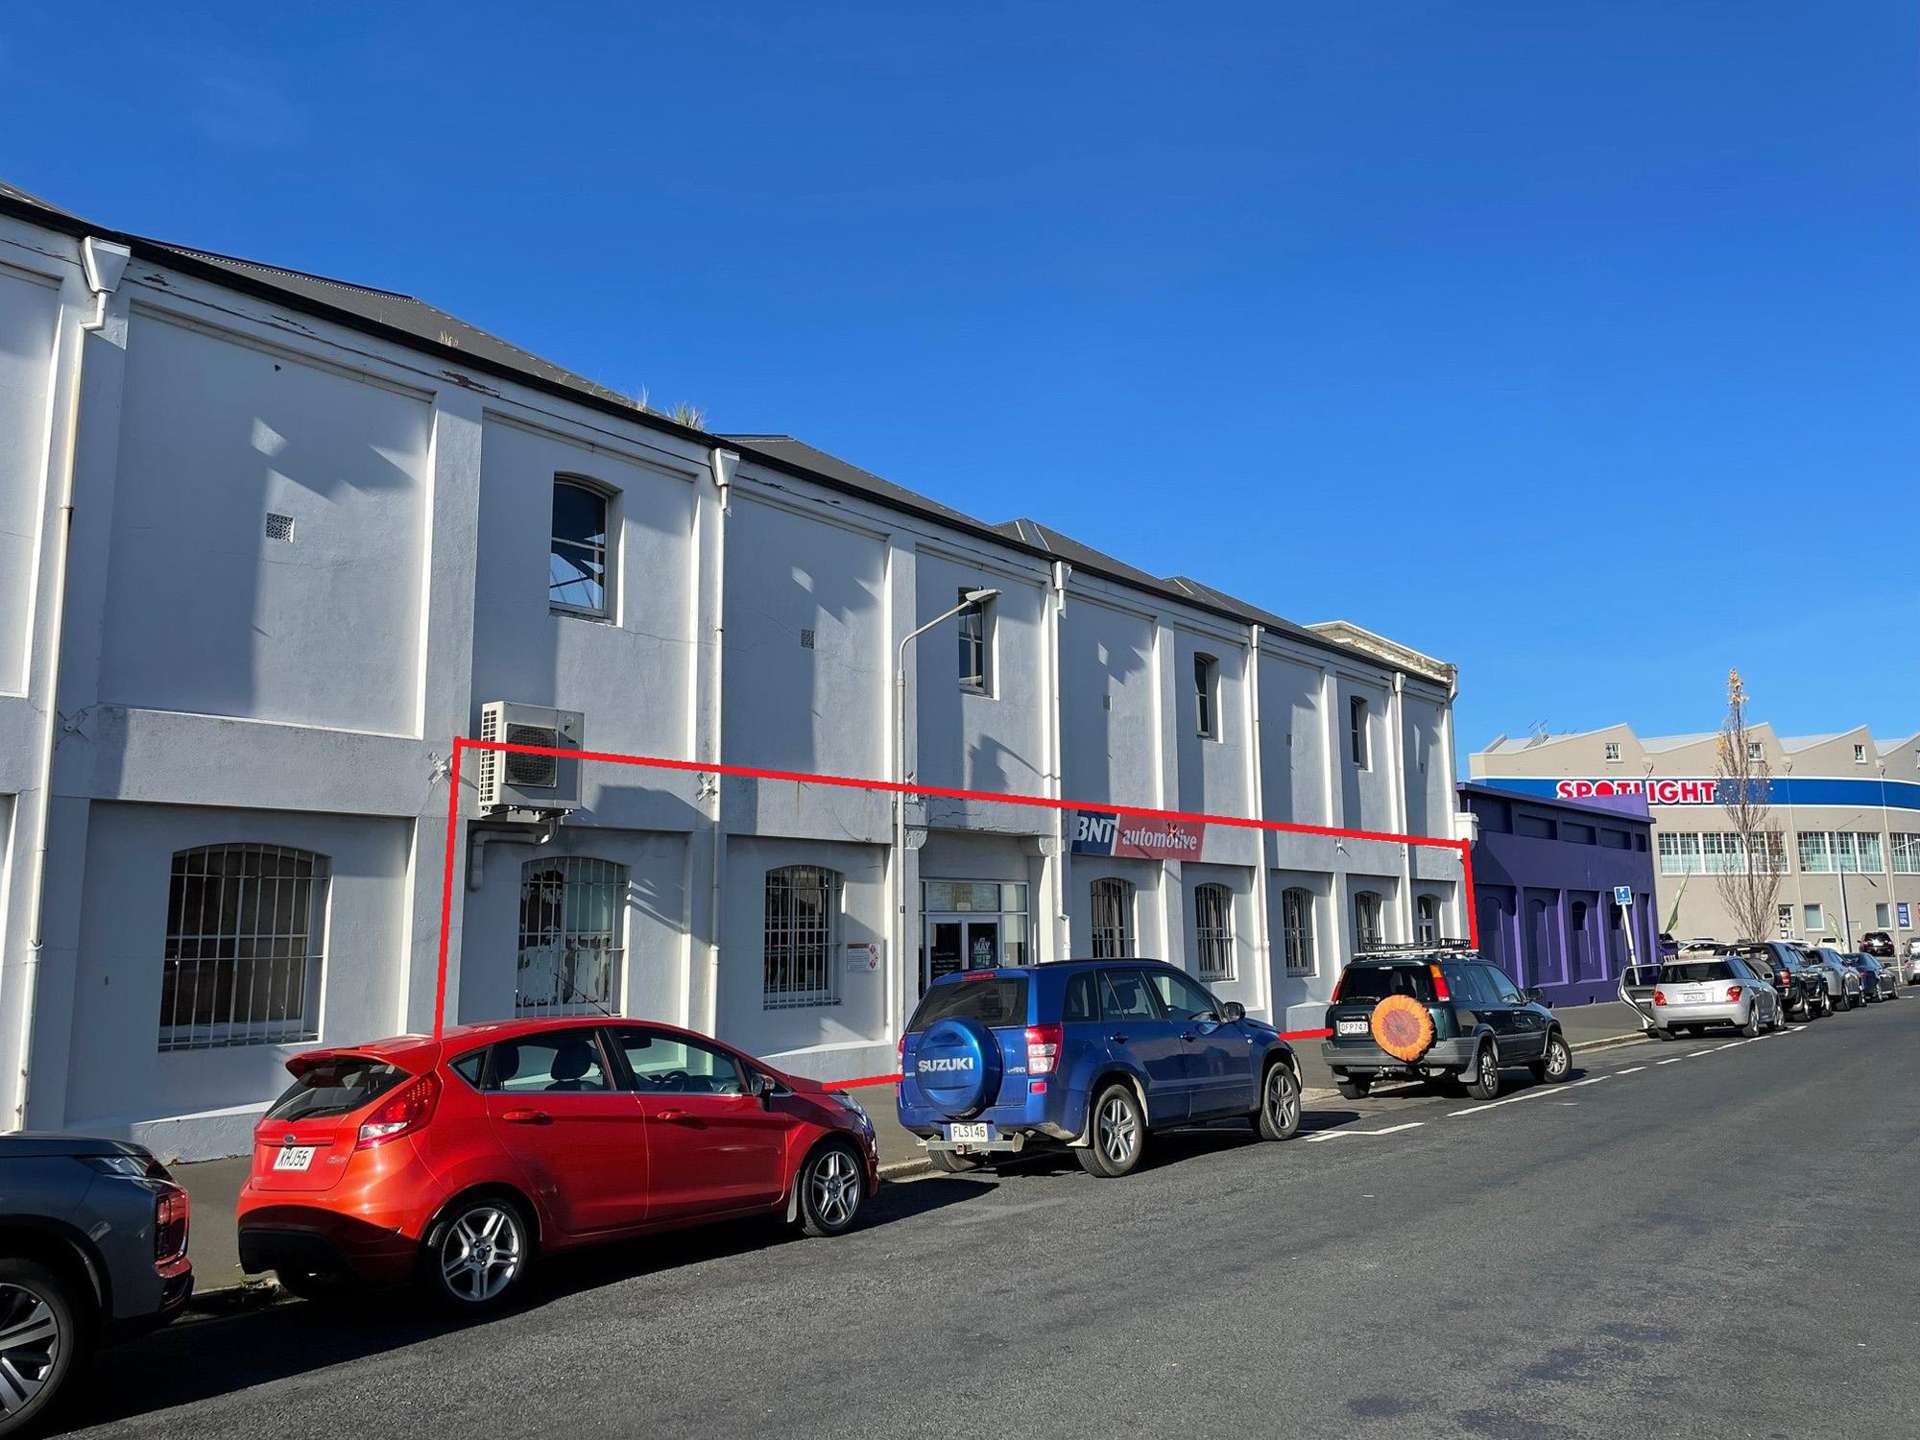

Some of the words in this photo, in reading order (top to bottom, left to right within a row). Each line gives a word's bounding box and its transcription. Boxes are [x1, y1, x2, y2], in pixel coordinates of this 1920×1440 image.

[1556, 780, 1716, 803] SPOTLIGHT
[1077, 816, 1116, 843] BNT
[1122, 826, 1197, 850] automotive
[918, 1057, 973, 1072] SUZUKI
[953, 1126, 985, 1137] FLS146
